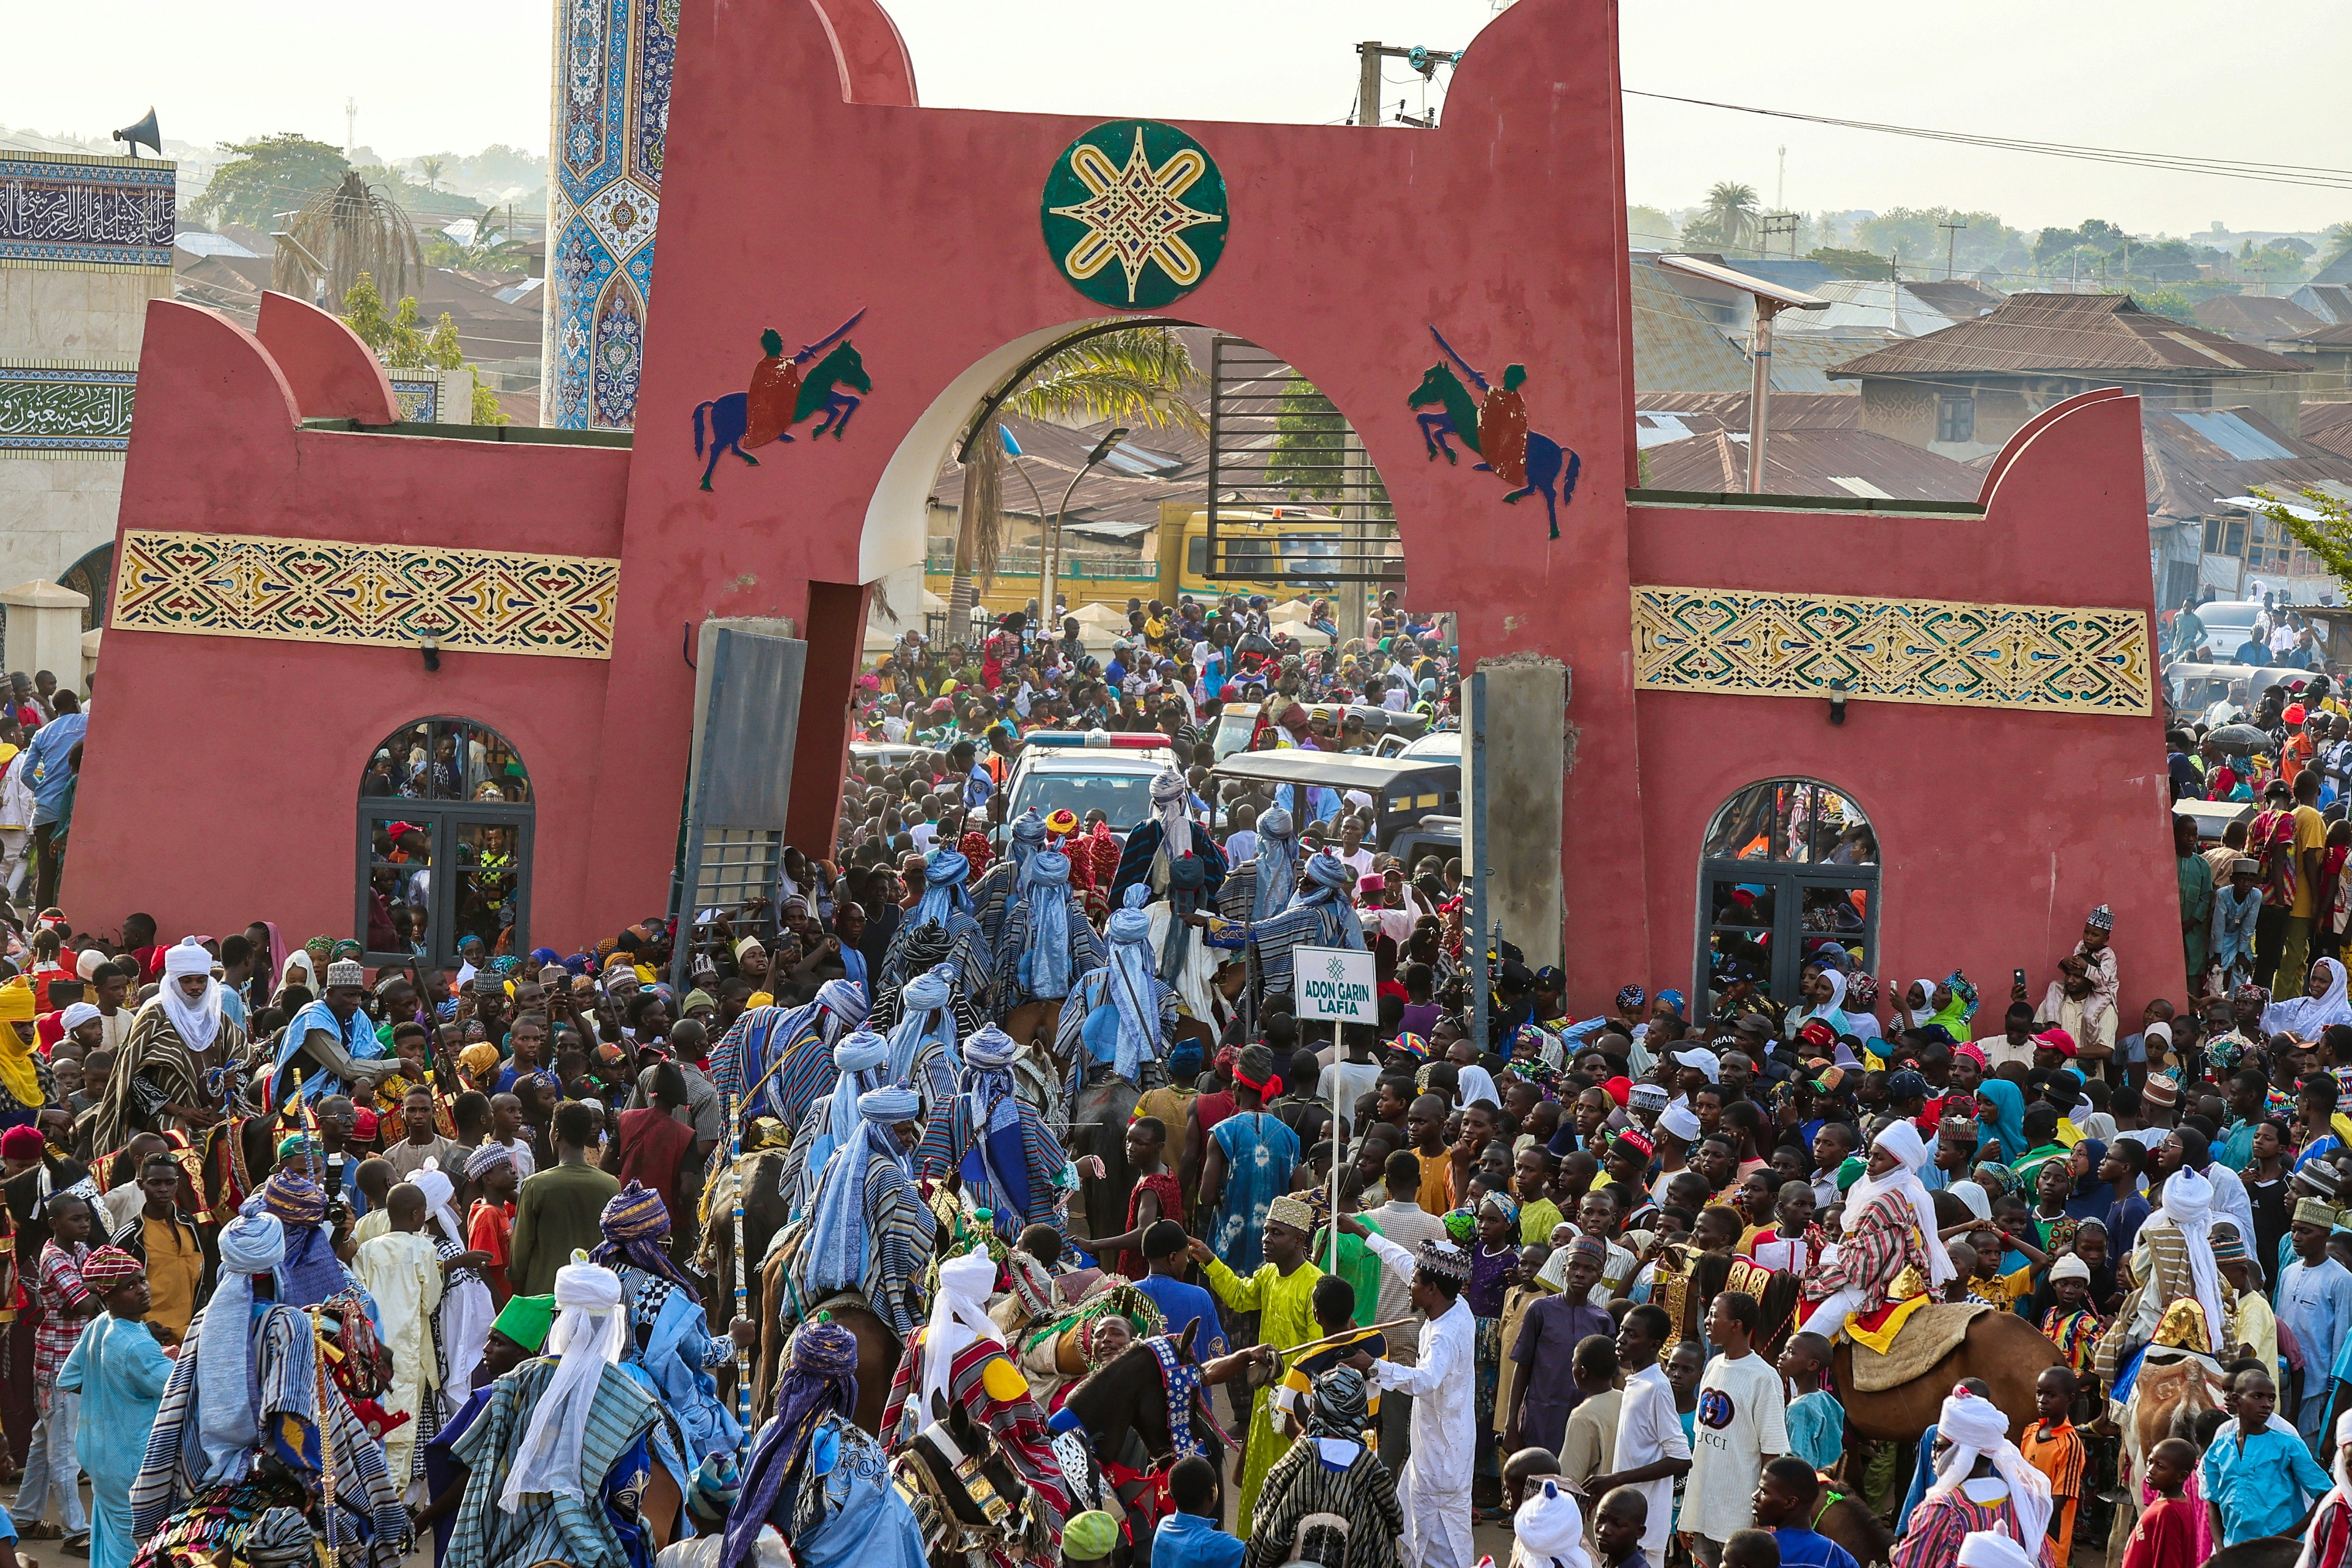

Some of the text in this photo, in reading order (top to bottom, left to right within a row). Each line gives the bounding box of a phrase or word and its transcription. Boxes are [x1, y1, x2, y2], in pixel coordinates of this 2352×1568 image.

[1305, 980, 1370, 1002] ADON GARIN
[1318, 999, 1359, 1015] LAFIA
[1711, 1035, 1736, 1047] CHAN
